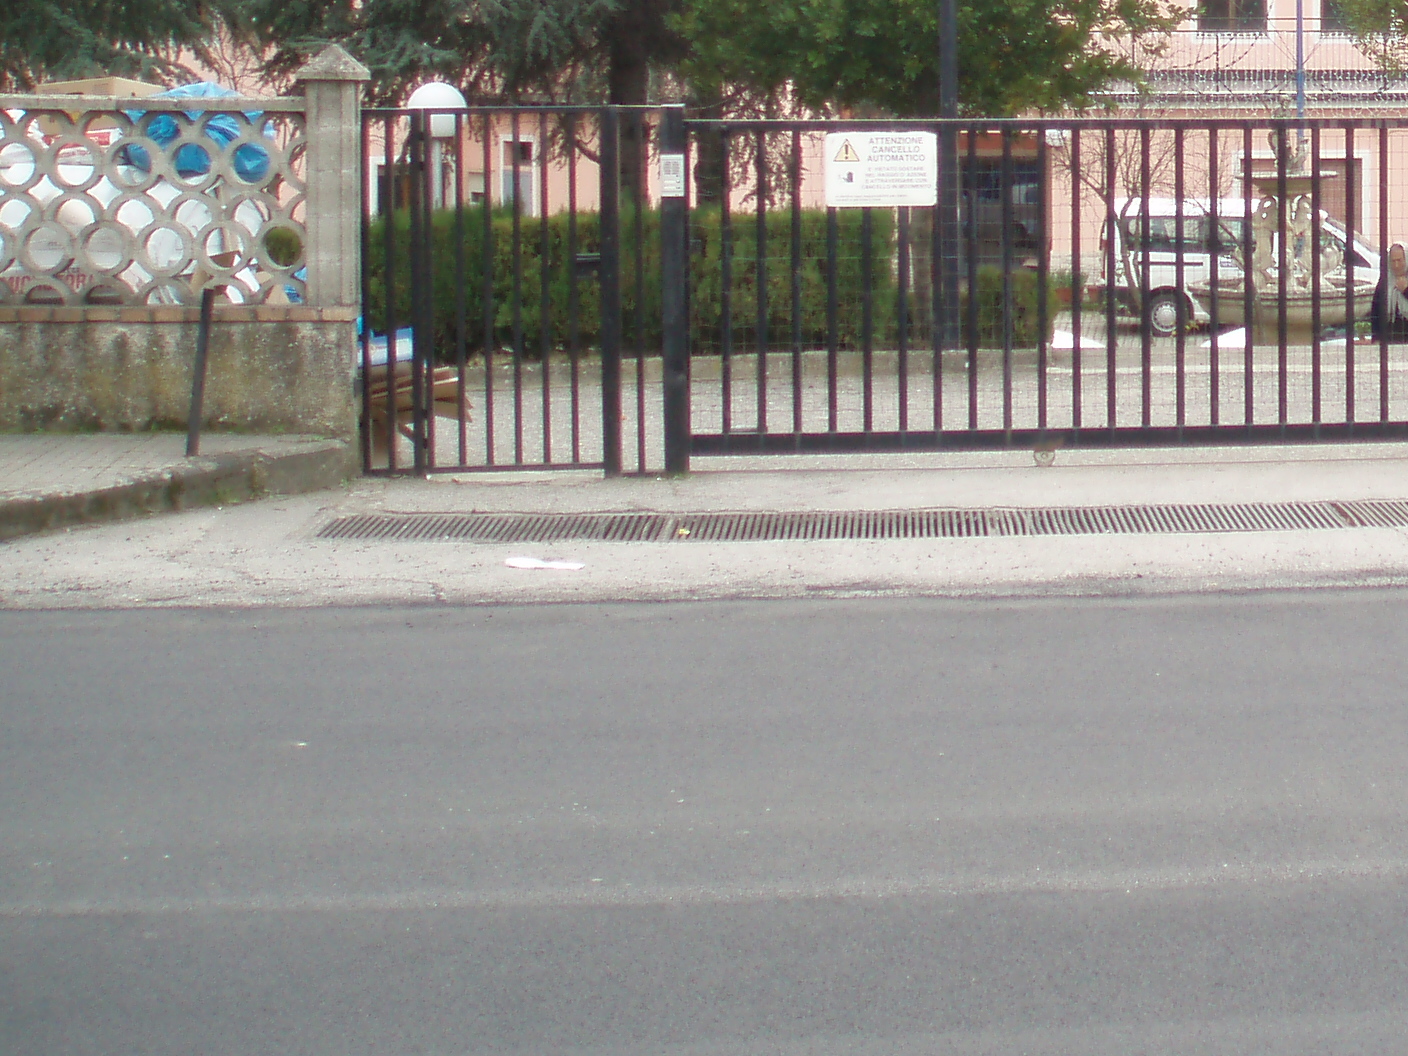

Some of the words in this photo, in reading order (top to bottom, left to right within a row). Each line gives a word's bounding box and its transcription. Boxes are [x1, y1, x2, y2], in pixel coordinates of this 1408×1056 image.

[868, 137, 924, 145] ATTENZIONE
[871, 145, 920, 153] CANCELLO
[867, 154, 926, 162] AUTOMATICO
